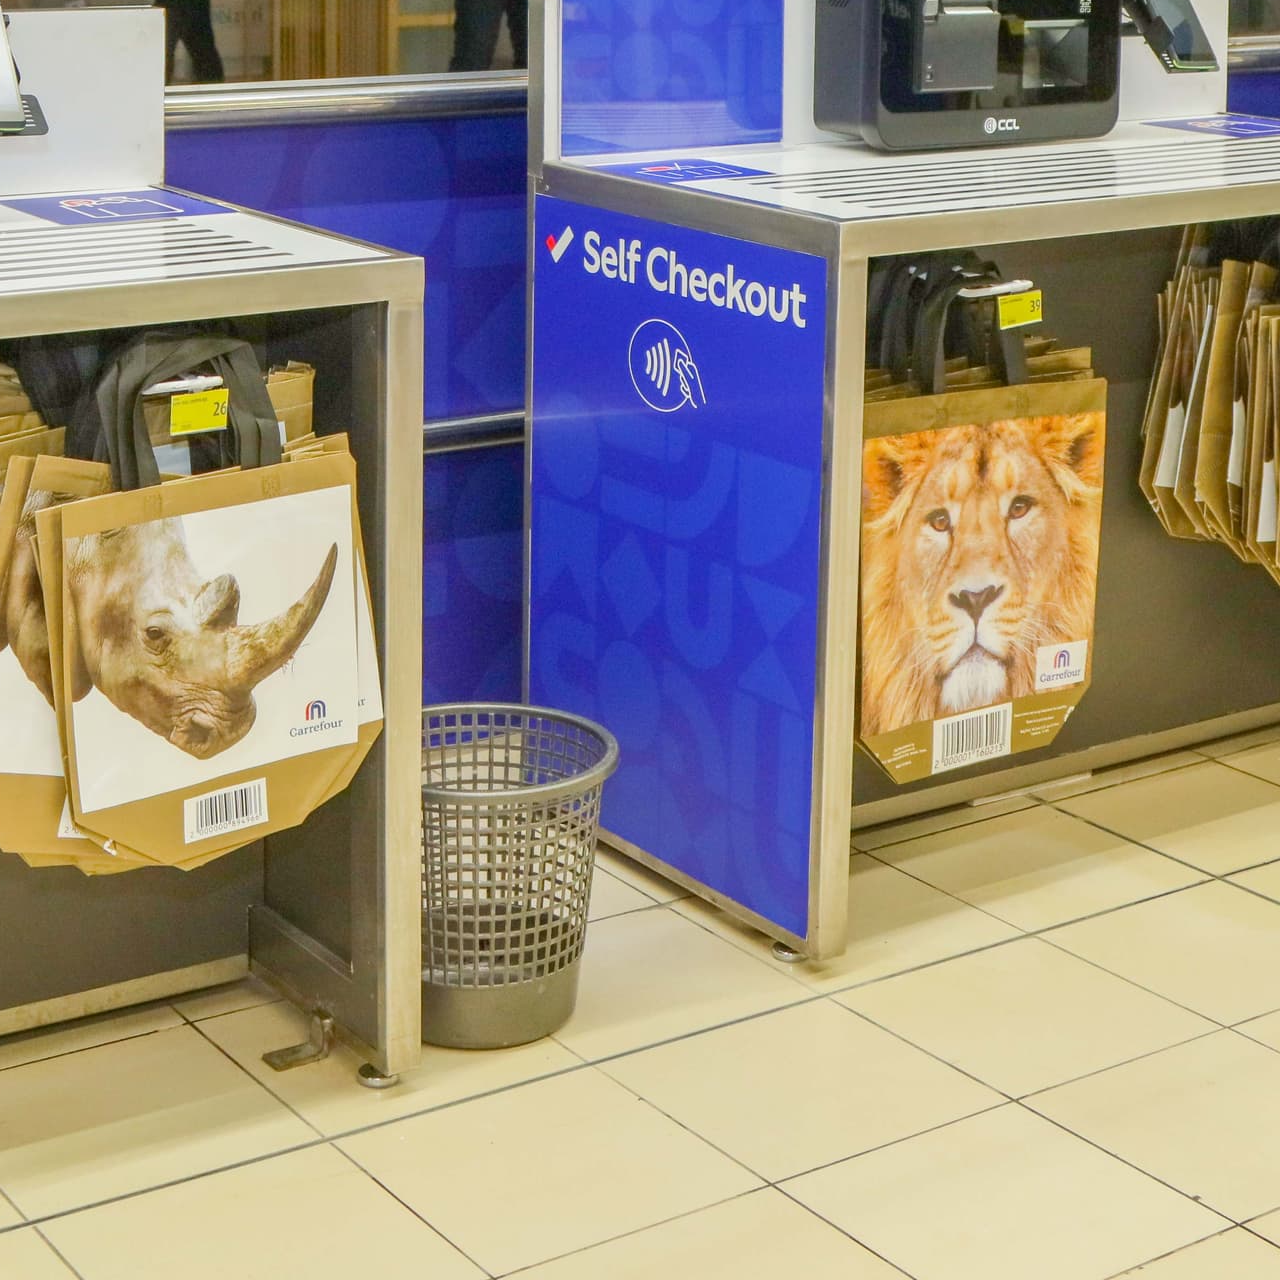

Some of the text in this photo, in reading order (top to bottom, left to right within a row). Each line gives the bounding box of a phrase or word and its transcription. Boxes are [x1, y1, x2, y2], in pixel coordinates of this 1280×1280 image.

[998, 119, 1019, 131] CCL
[583, 230, 807, 328] Self Checkout
[1030, 300, 1040, 312] 39
[213, 402, 226, 416] 26
[1039, 667, 1081, 684] Carrefour
[290, 720, 343, 737] Carrefour
